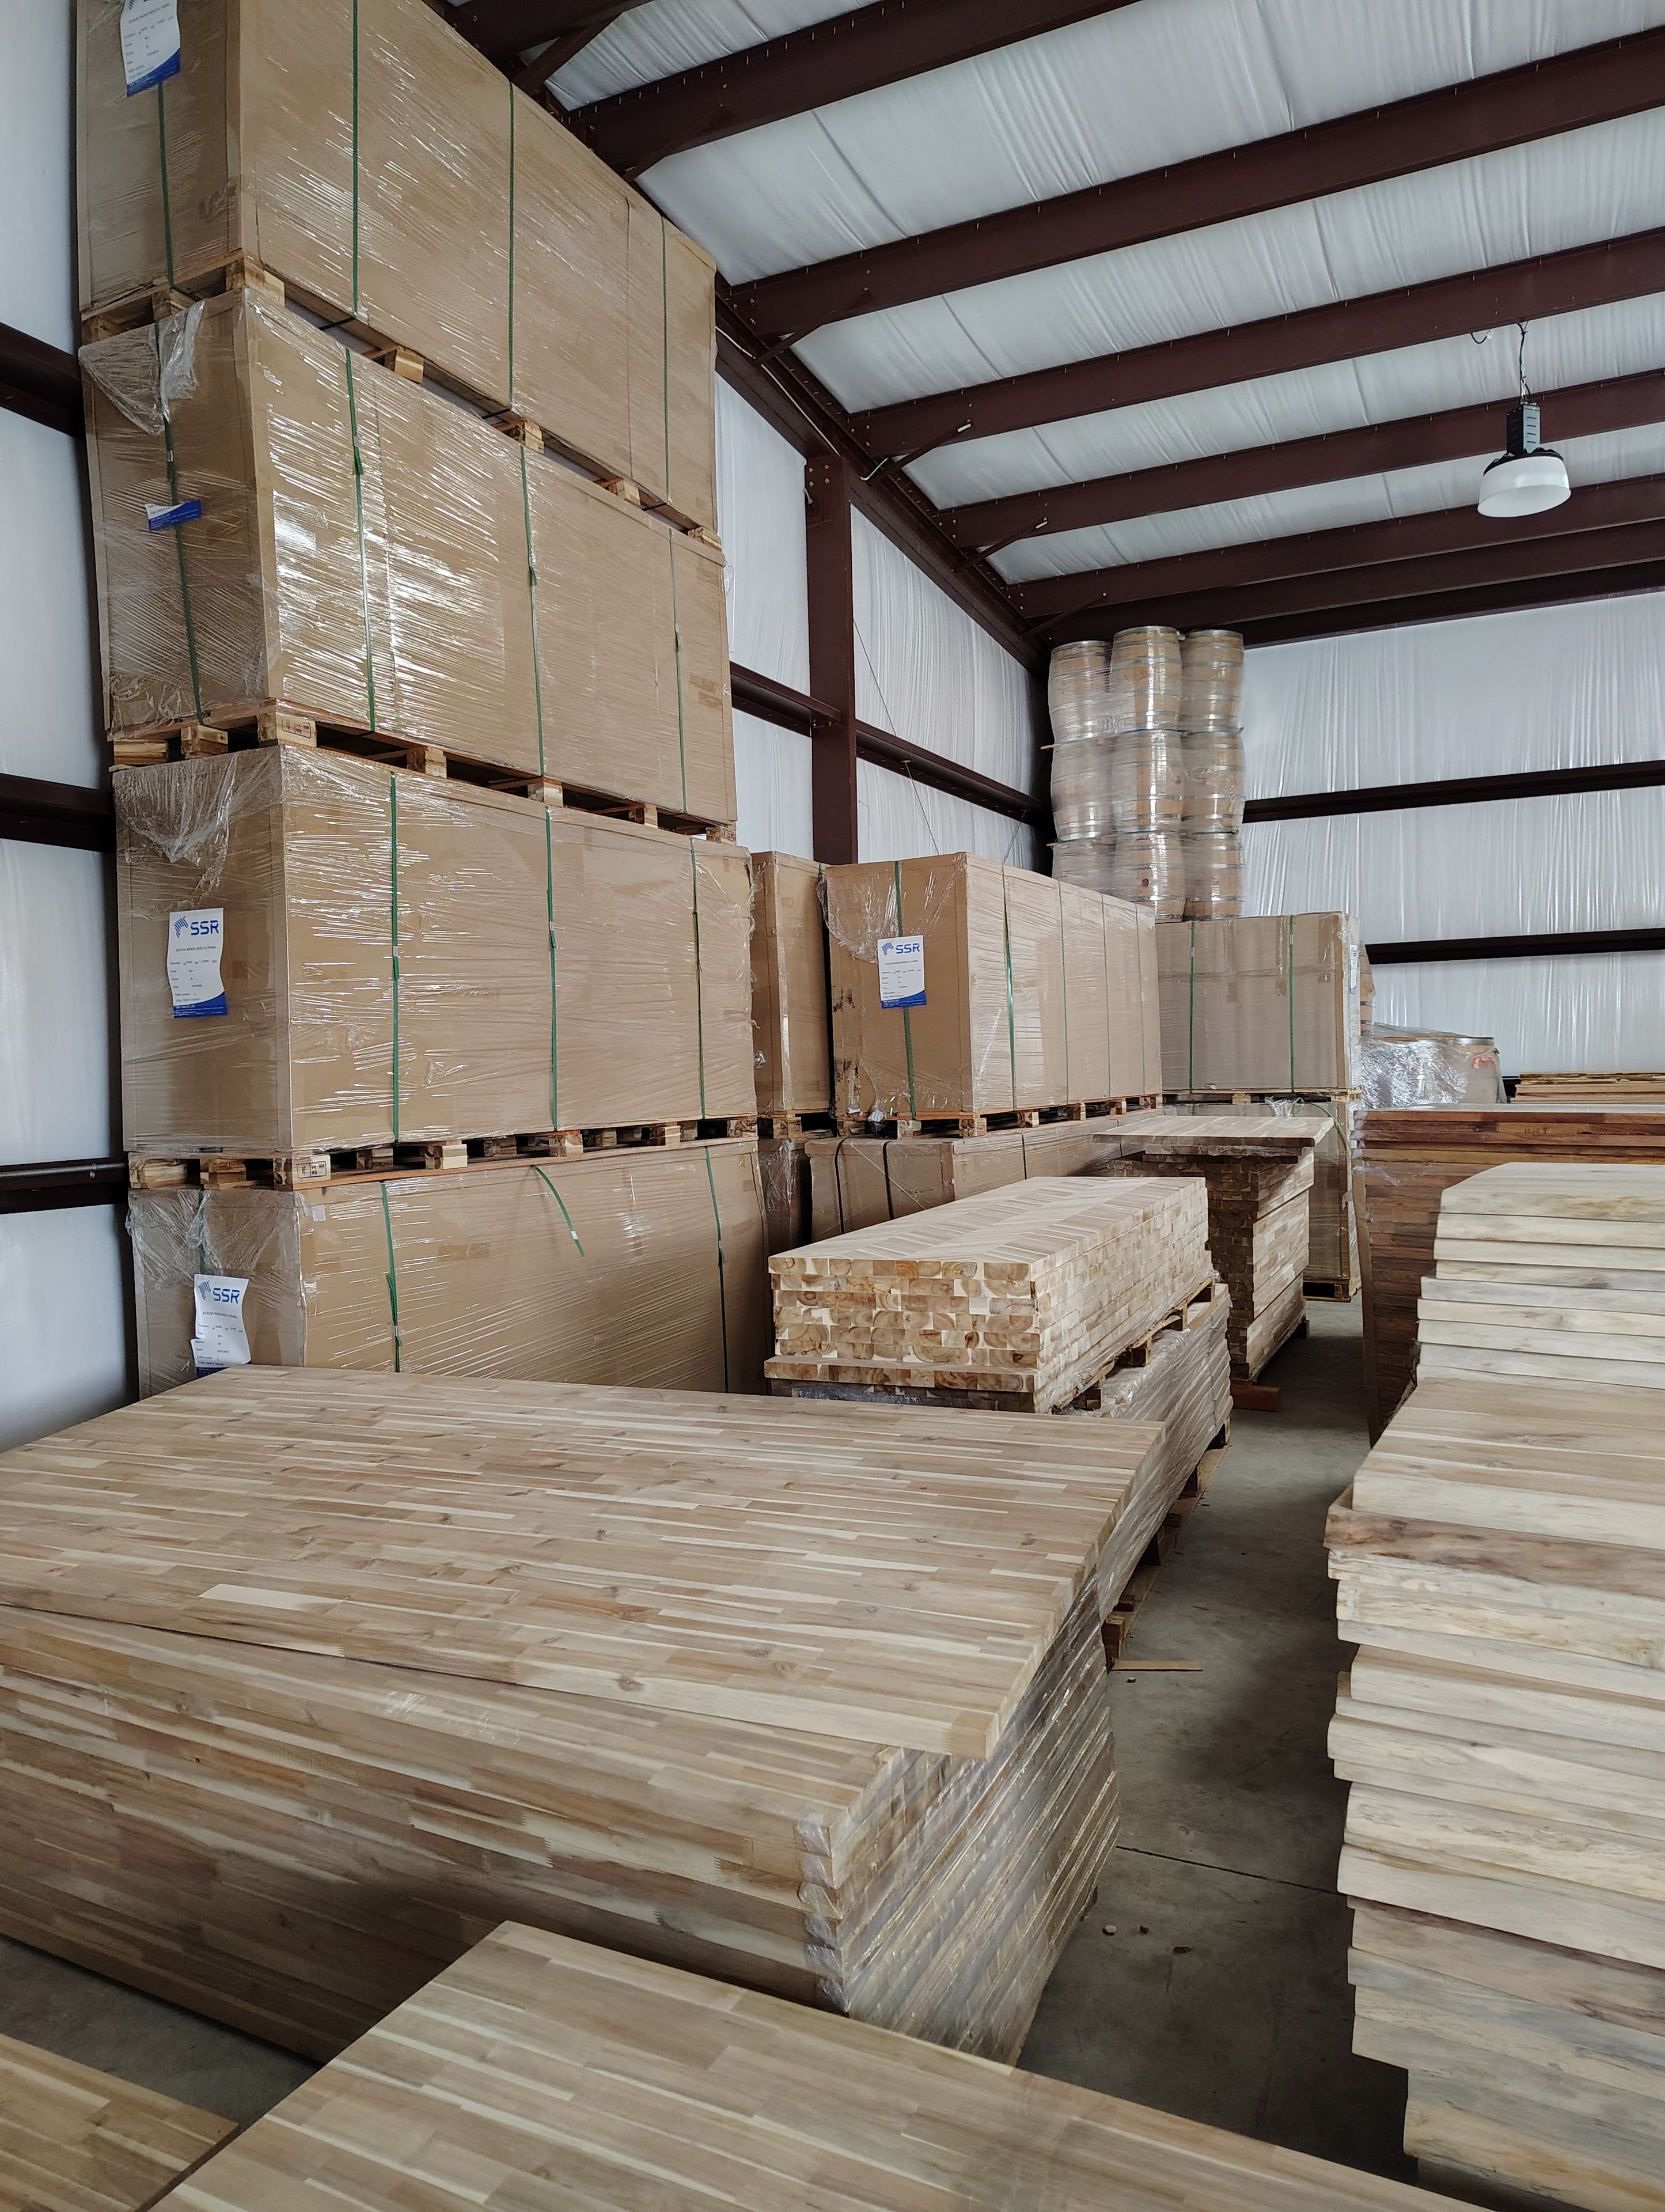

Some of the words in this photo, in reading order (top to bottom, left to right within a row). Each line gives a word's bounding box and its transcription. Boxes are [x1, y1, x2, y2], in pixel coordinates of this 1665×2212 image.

[191, 920, 219, 935] SSR
[896, 943, 920, 954] SSR
[213, 1287, 240, 1304] SSR
